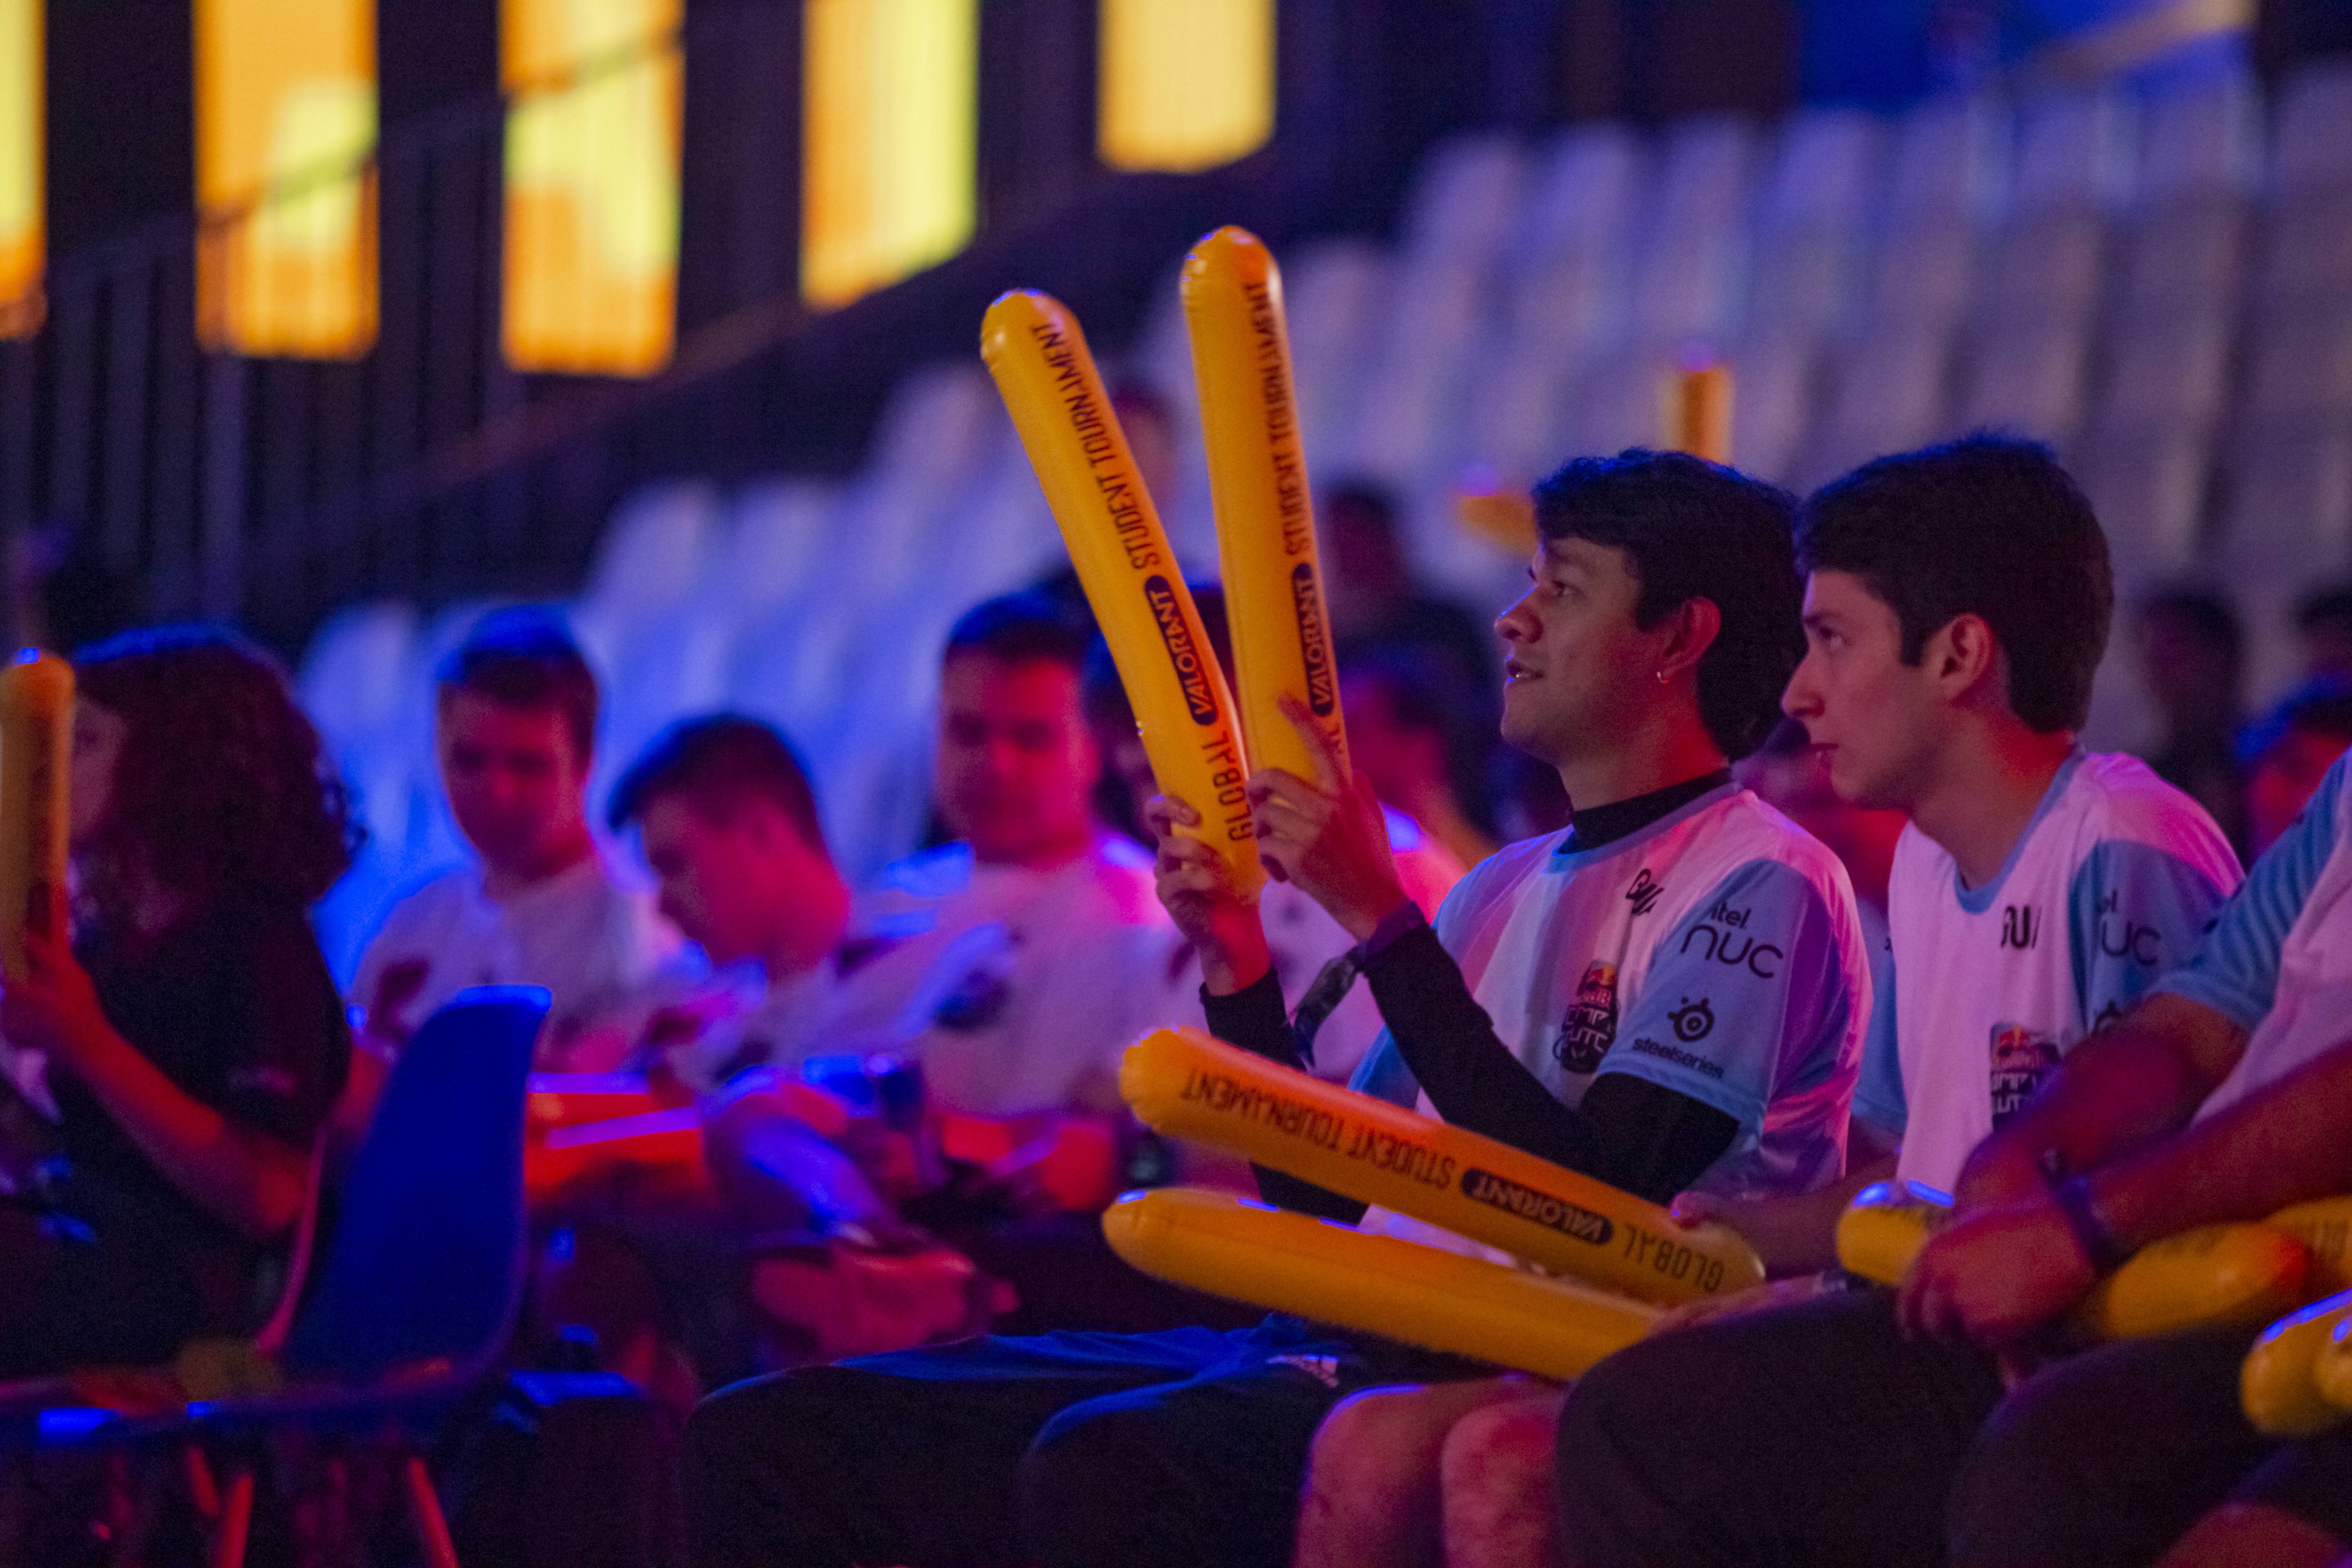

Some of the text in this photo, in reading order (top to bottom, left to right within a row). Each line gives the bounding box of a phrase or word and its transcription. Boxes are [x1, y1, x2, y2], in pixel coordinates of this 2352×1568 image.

[1272, 453, 1309, 556] STUDENT
[1033, 323, 1254, 842] GLOBAL VALORANT STUDENT TOURNAMENT
[1296, 579, 1333, 707] VALORANT
[1631, 1037, 1725, 1079] steelseries
[1180, 1068, 1724, 1293] GLOBAL VALORANT STUDENT TOURNAMENT
